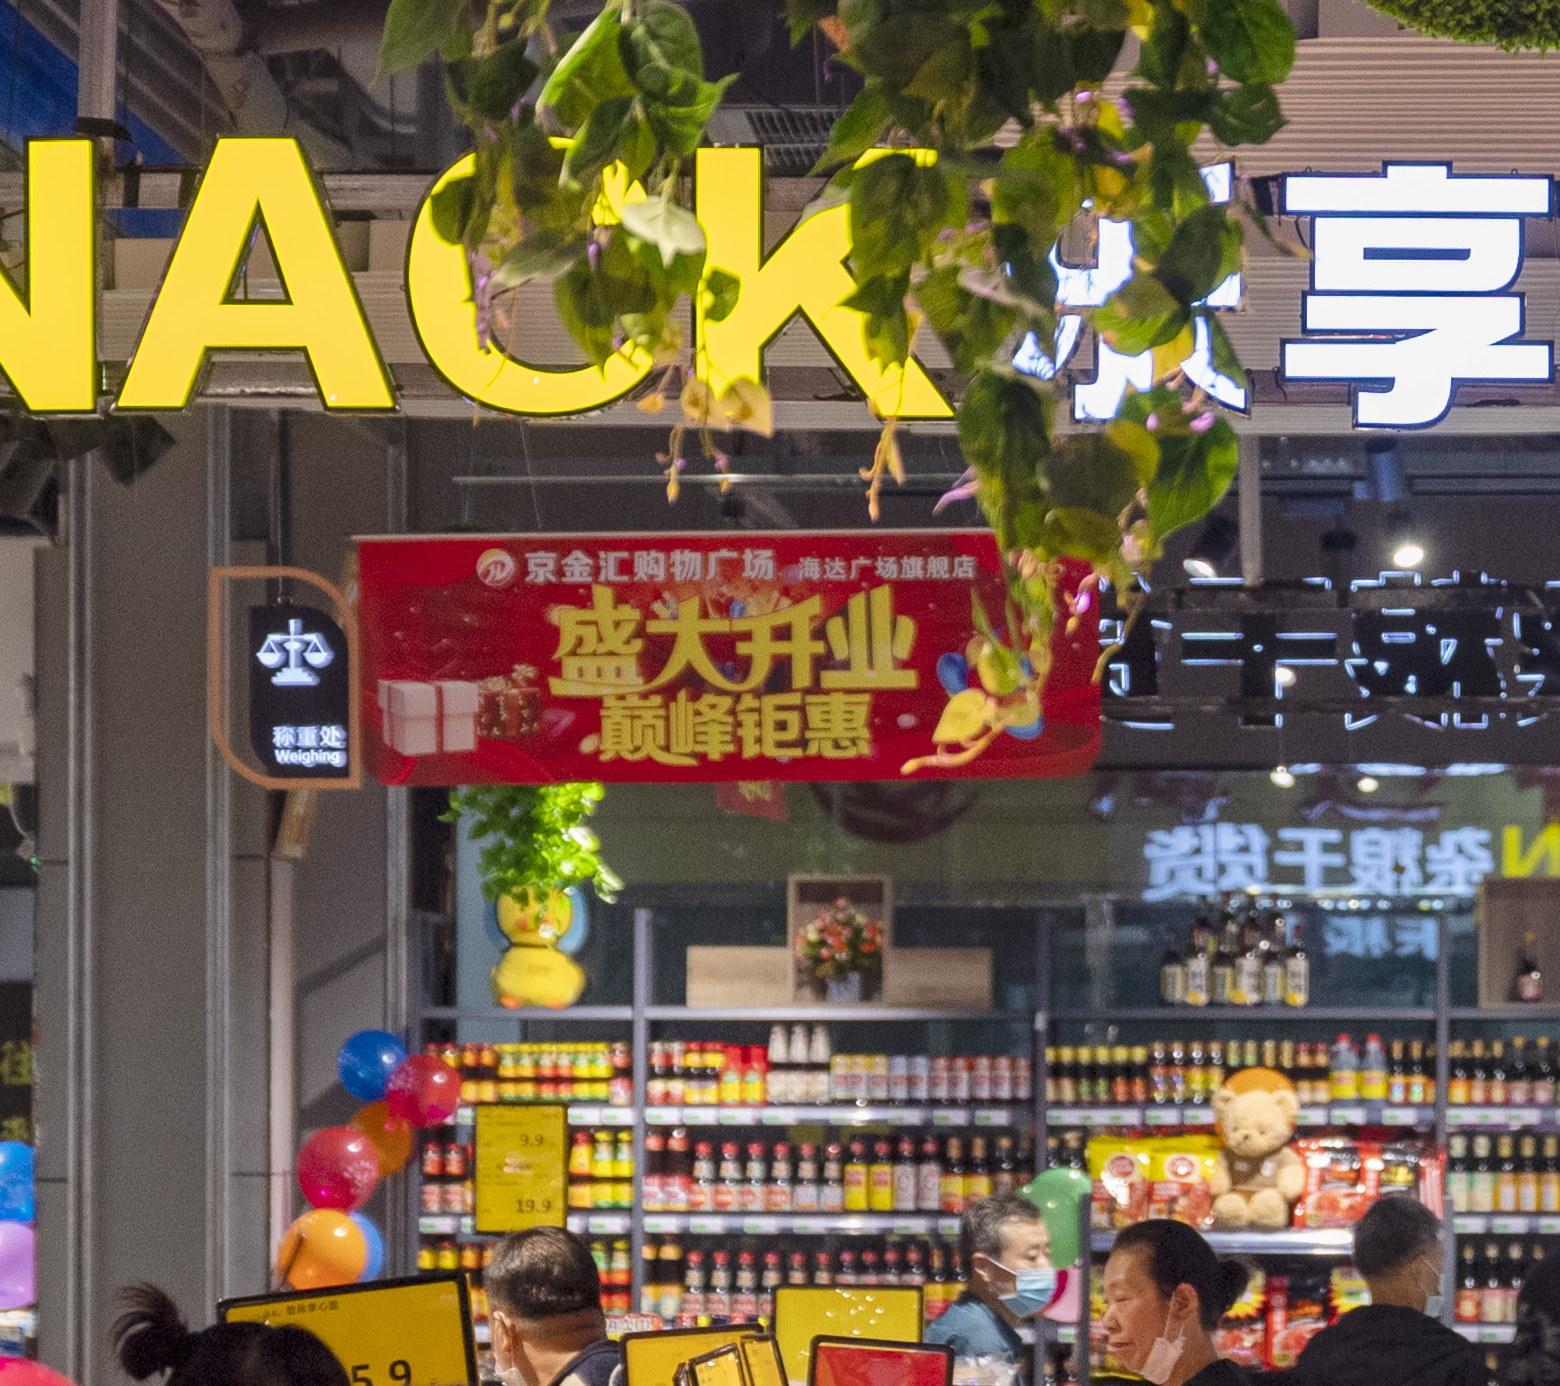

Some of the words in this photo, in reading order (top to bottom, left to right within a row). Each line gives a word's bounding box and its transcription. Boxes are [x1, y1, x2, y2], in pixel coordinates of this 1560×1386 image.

[523, 547, 777, 584] 京金汇购物广场
[797, 553, 977, 583] 海达广场旗舰店
[548, 583, 920, 697] 盛大开业
[272, 724, 346, 749] 称重处
[598, 691, 873, 766] 巅峰钜惠
[274, 749, 347, 767] Weighing
